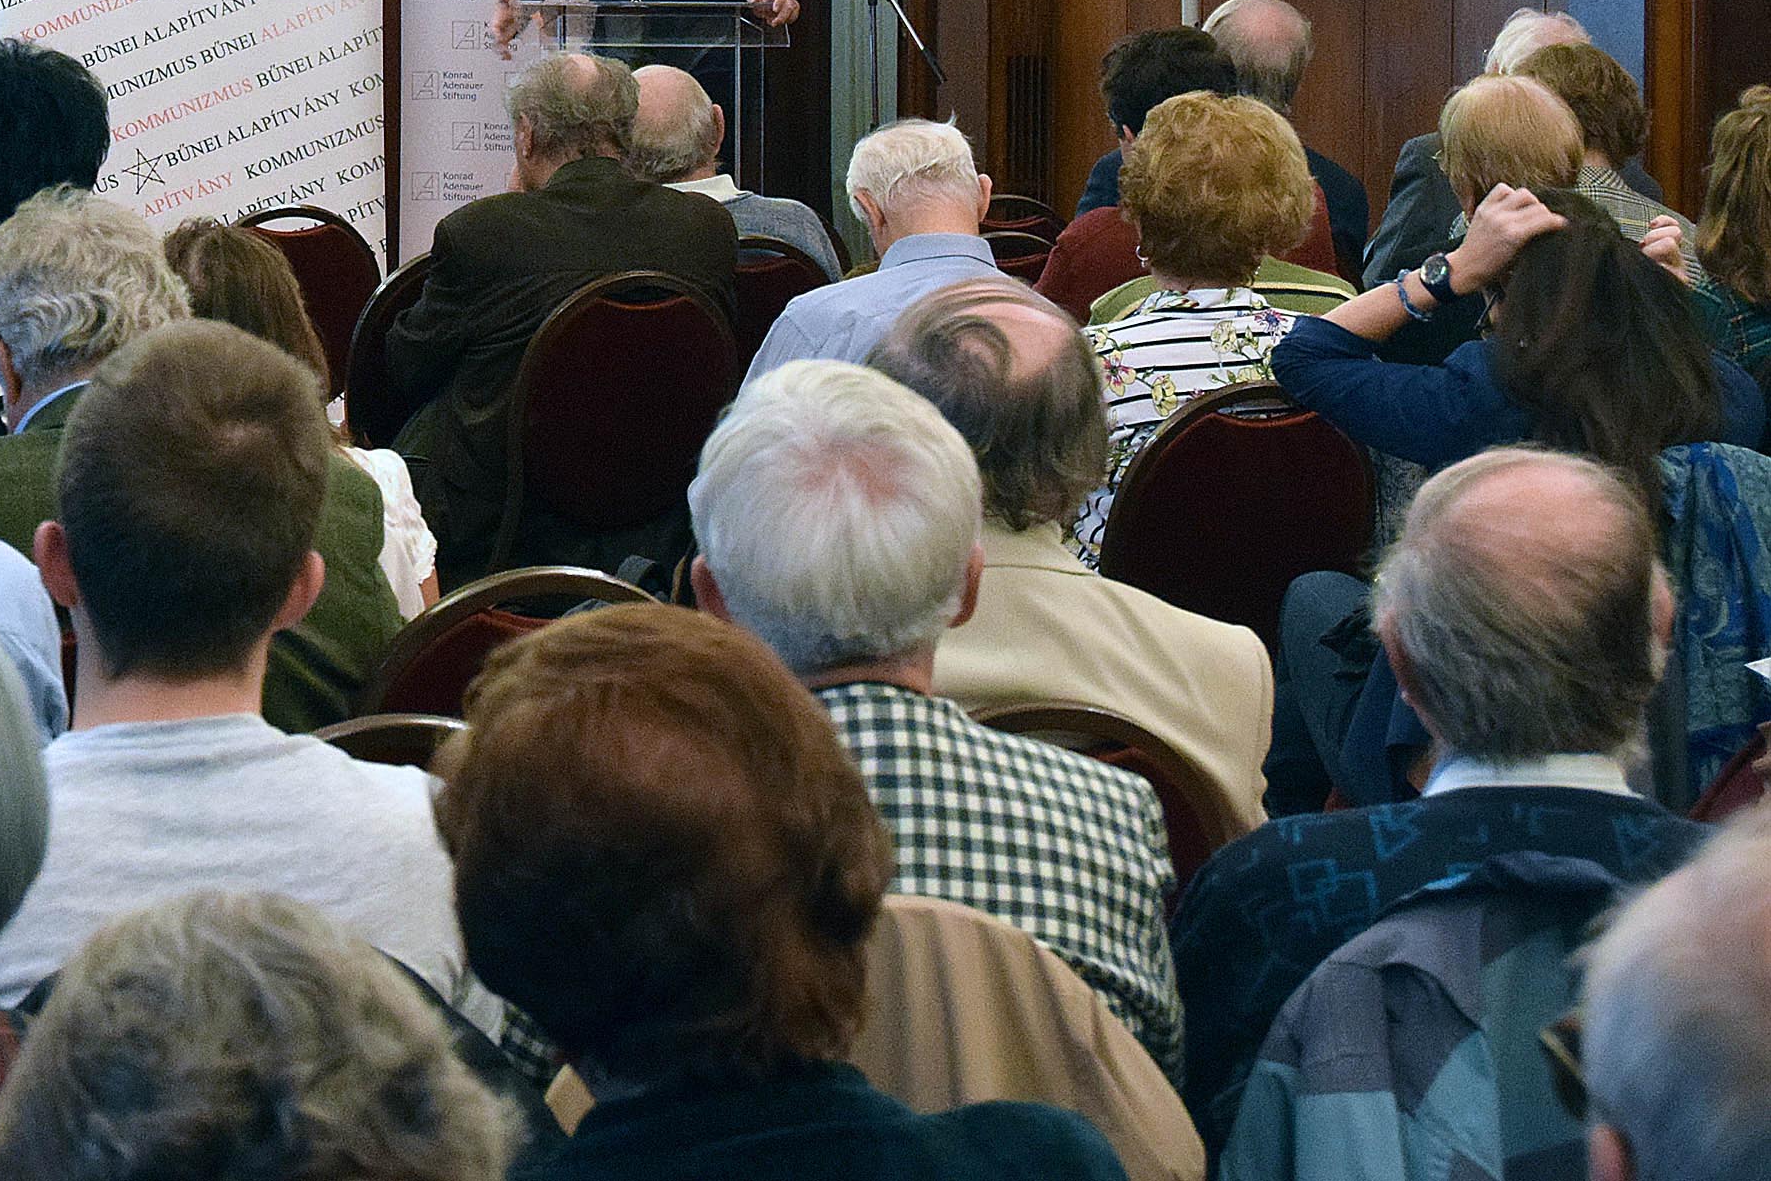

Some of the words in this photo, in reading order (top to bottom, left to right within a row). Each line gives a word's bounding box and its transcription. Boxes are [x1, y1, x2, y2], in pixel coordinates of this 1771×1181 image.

[81, 35, 140, 69] BŰNEI
[199, 31, 259, 65] BŰNEI
[442, 71, 474, 80] Konrad
[442, 82, 484, 91] Adenauer
[111, 76, 254, 143] KOMMUNIZMUS
[255, 54, 314, 89] BŰNEI
[442, 92, 477, 102] Stiftung
[164, 133, 224, 168] BŰNEI
[227, 89, 341, 145] ALAPÍTVÁNY
[243, 114, 385, 179] KOMMUNIZMUS
[443, 172, 474, 181] Konrad
[443, 183, 484, 192] Adenauer
[443, 193, 478, 203] Stiftung
